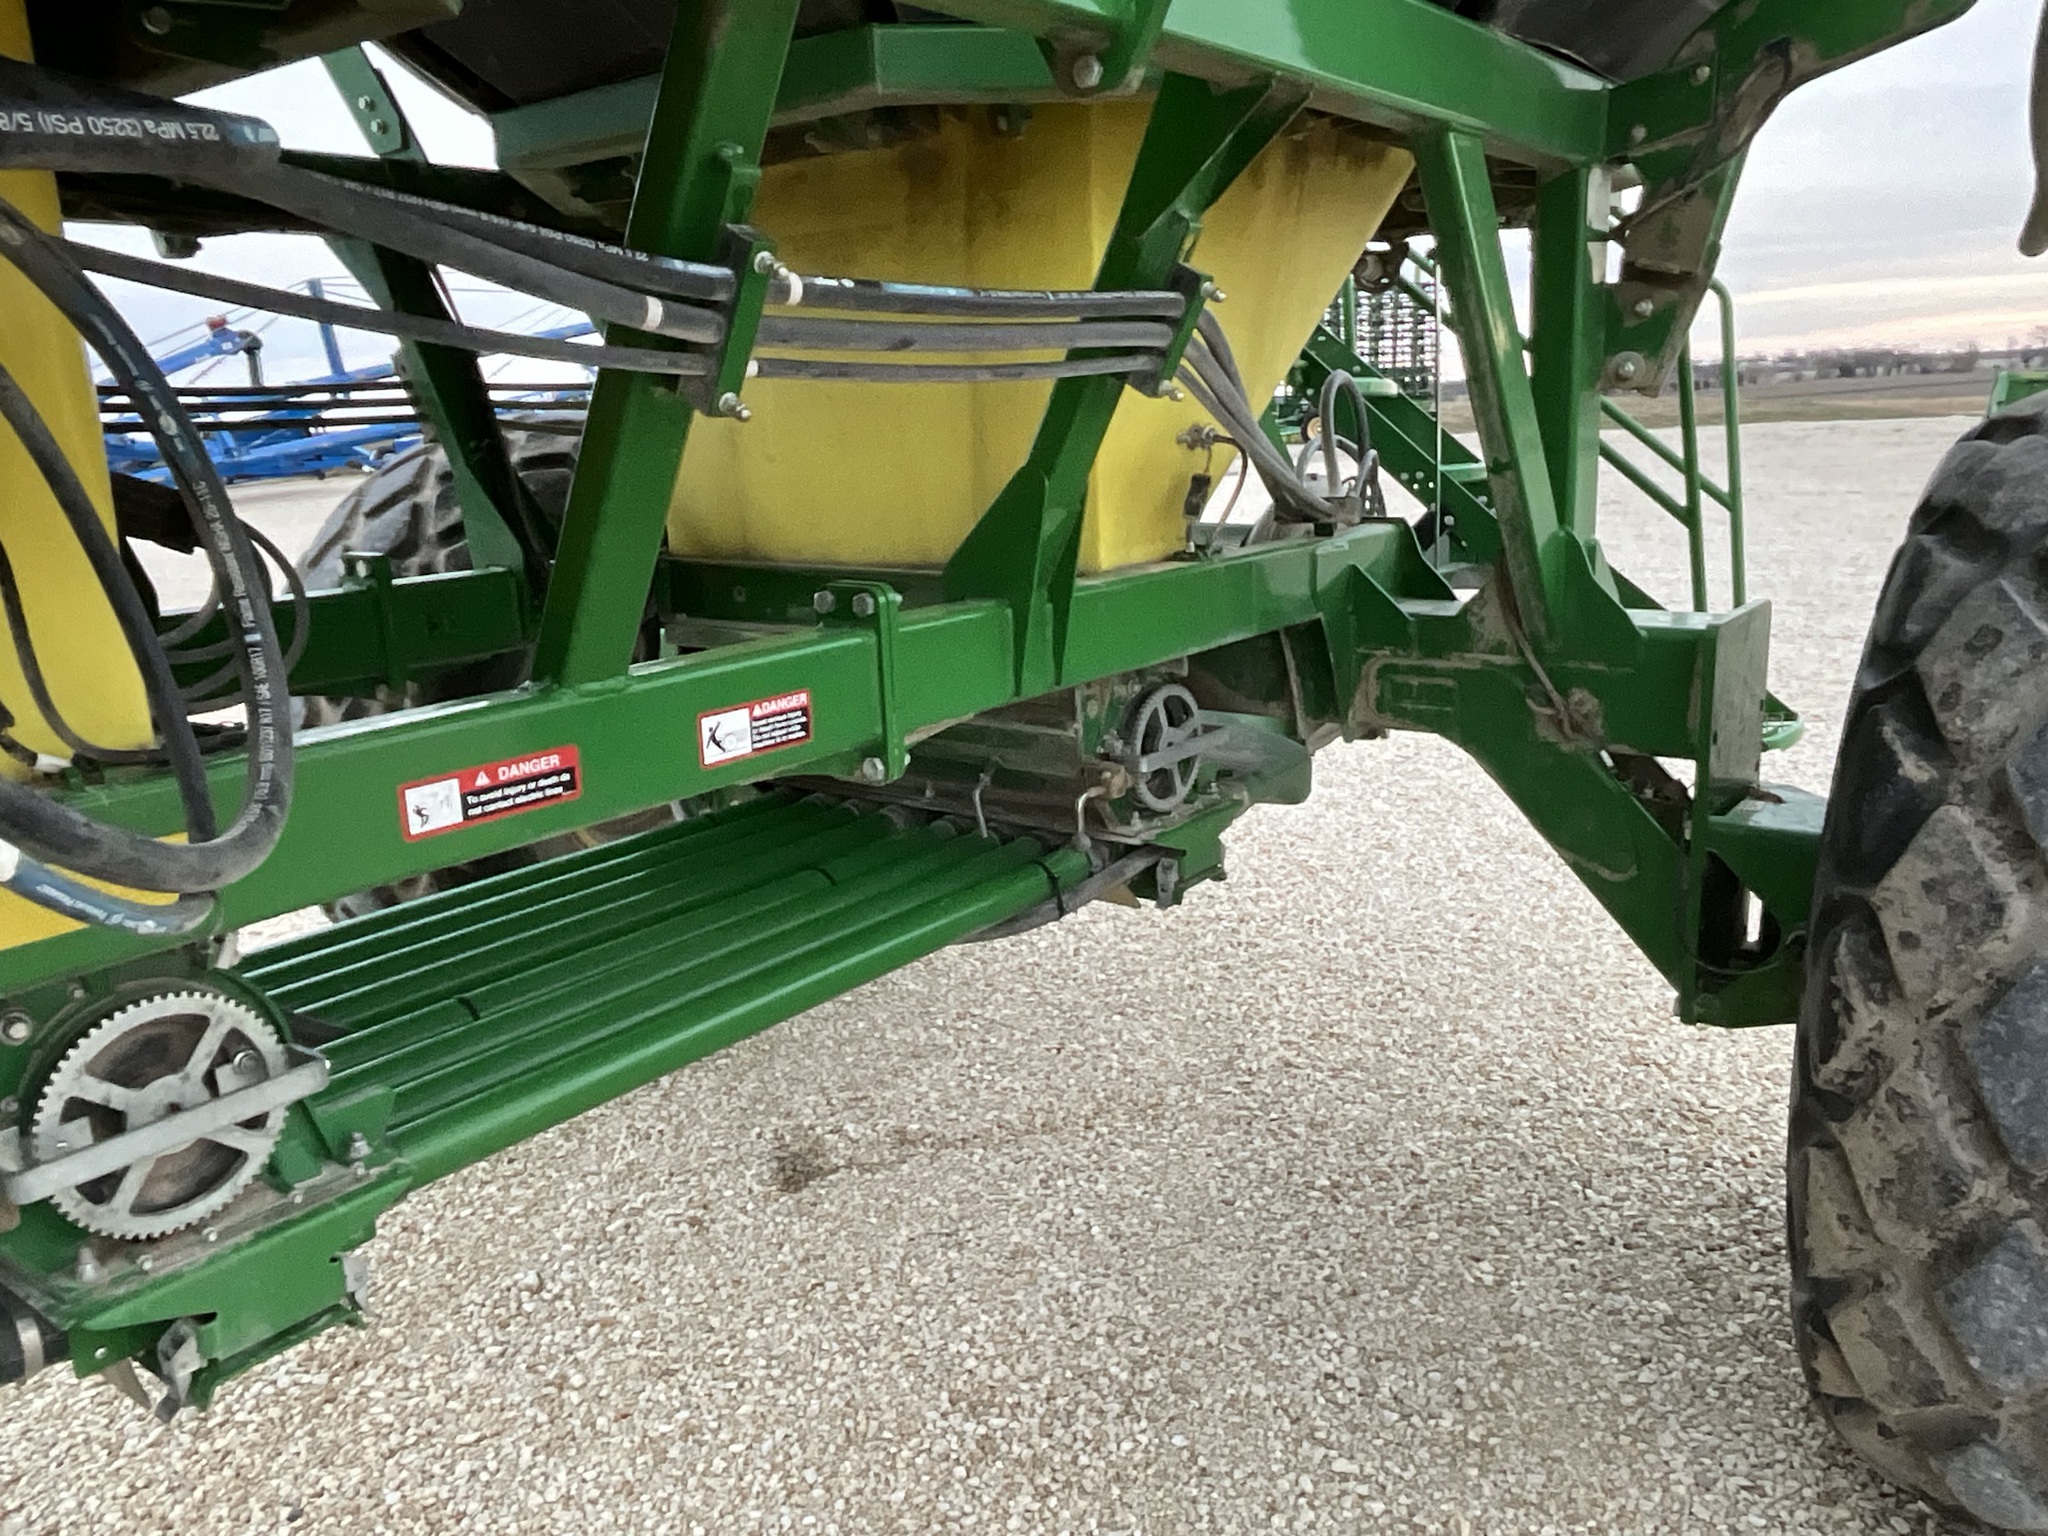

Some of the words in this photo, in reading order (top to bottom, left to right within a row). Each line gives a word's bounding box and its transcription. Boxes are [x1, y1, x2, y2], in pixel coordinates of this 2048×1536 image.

[38, 111, 85, 135] PSI)
[87, 116, 142, 138] (3250
[146, 119, 186, 139] MPa
[761, 693, 808, 712] DANGER
[498, 754, 560, 780] DANGER
